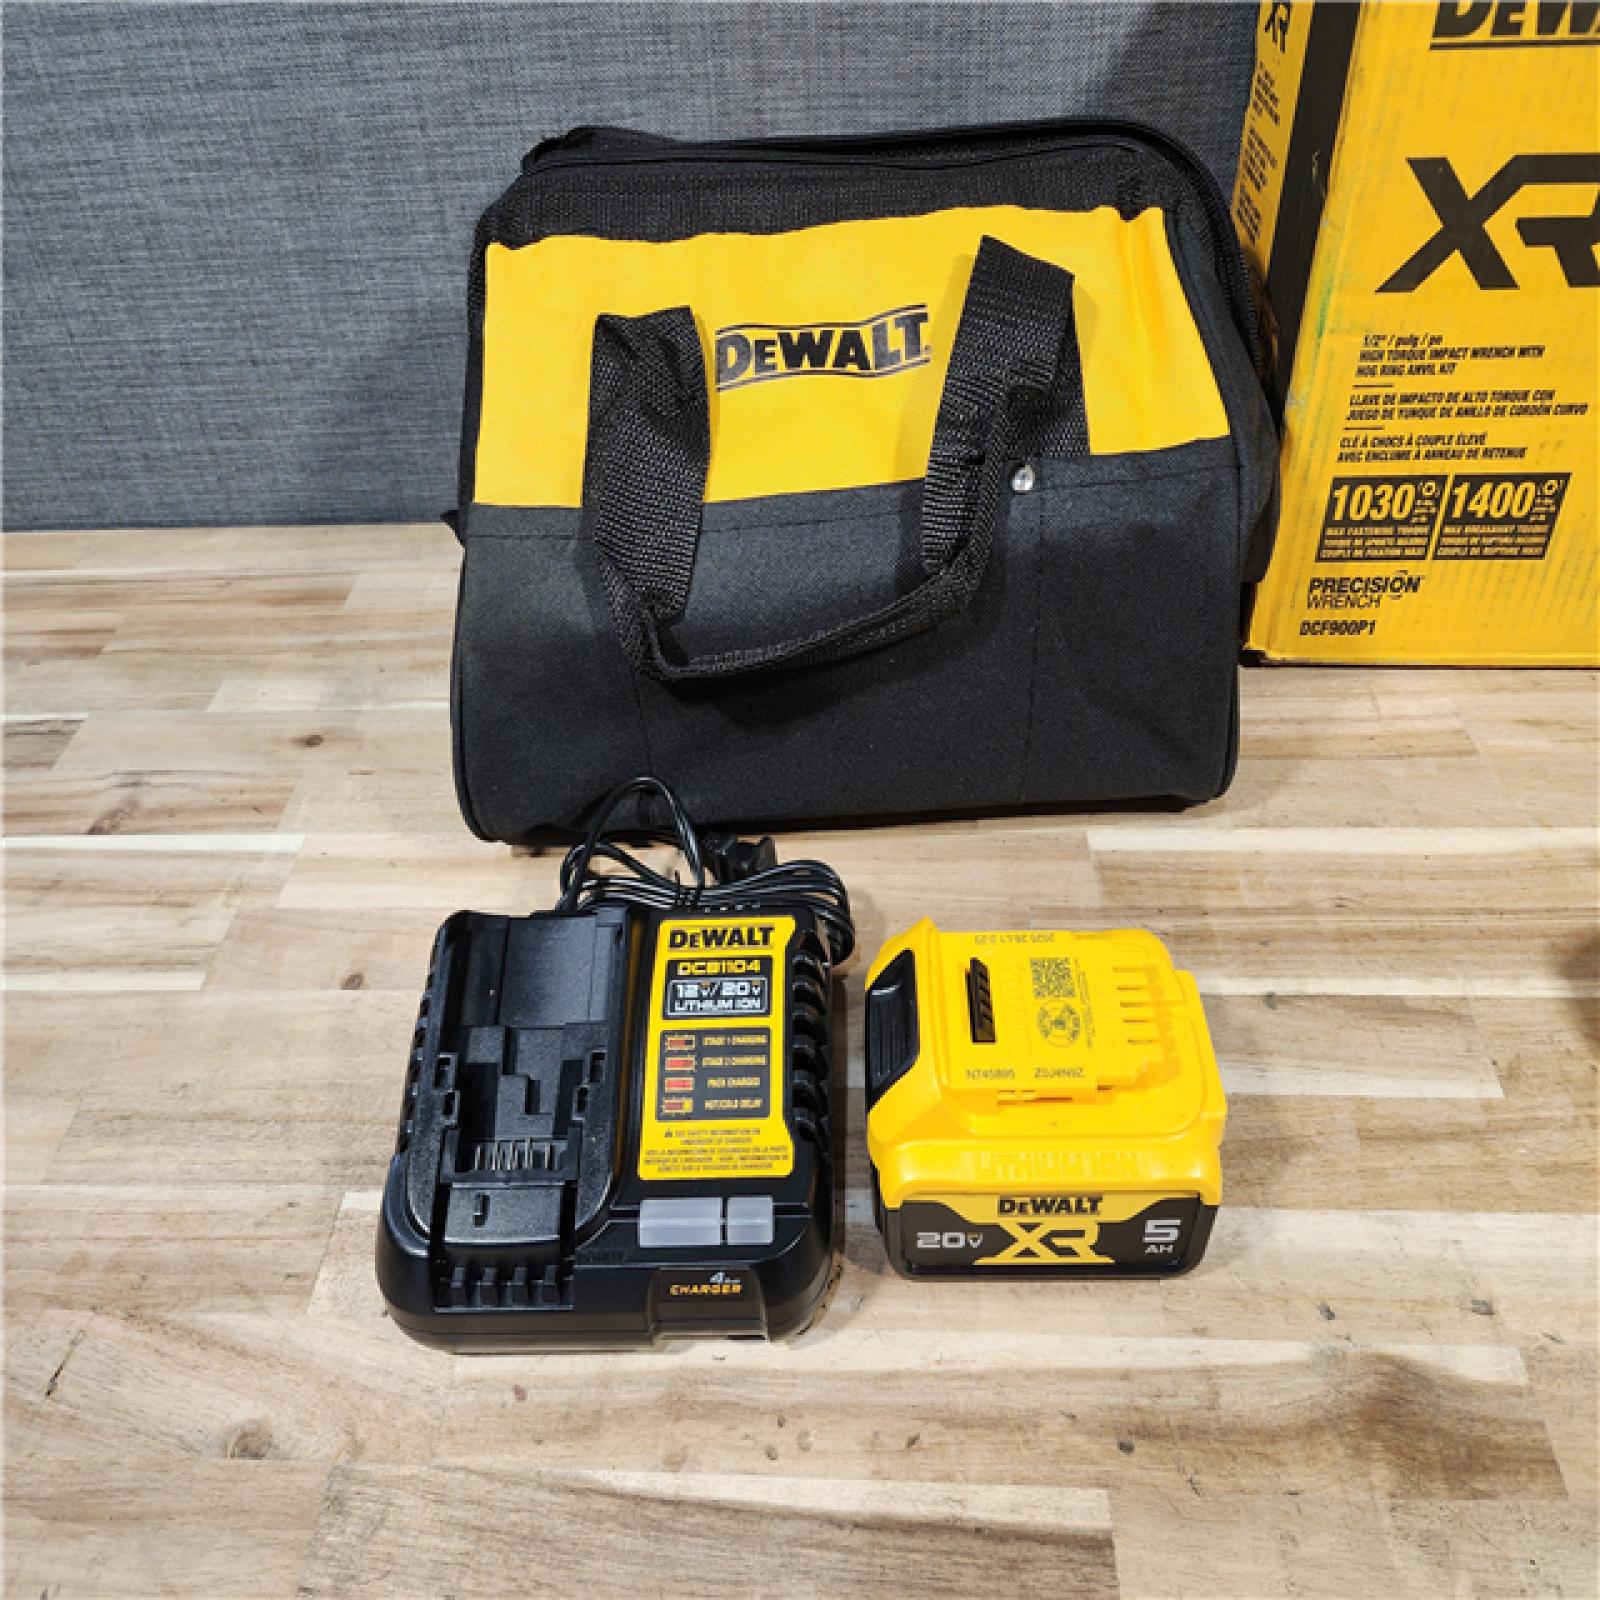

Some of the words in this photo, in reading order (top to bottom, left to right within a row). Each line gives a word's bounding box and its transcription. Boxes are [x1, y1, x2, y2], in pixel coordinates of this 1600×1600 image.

[1432, 2, 1600, 38] DEW
[715, 312, 930, 384] DEWALT
[1358, 349, 1385, 362] HIGH
[1387, 349, 1426, 362] TORQUE
[1429, 347, 1469, 360] IMPACT
[1470, 346, 1515, 359] WRENCH
[1517, 345, 1545, 358] WITH
[1379, 364, 1406, 376] RING
[1407, 363, 1436, 376] ANVIL
[1438, 362, 1457, 374] KIT
[1398, 391, 1445, 404] IMPACTO
[1462, 390, 1488, 403] ALTO
[1490, 389, 1531, 403] TORQUE
[1414, 433, 1454, 447] COUPLE
[1333, 483, 1417, 521] 1030
[1451, 481, 1537, 519] 1400
[1308, 575, 1422, 594] PRECISION
[1306, 593, 1382, 610] WRENCH
[1299, 619, 1377, 636] DCF900P1
[669, 926, 776, 949] DEWALT
[674, 998, 733, 1012] LITHIUM
[997, 1196, 1103, 1217] DEWALT
[1142, 1219, 1182, 1244] 5
[971, 1221, 1116, 1266] XR
[669, 1284, 744, 1296] CHARGER
